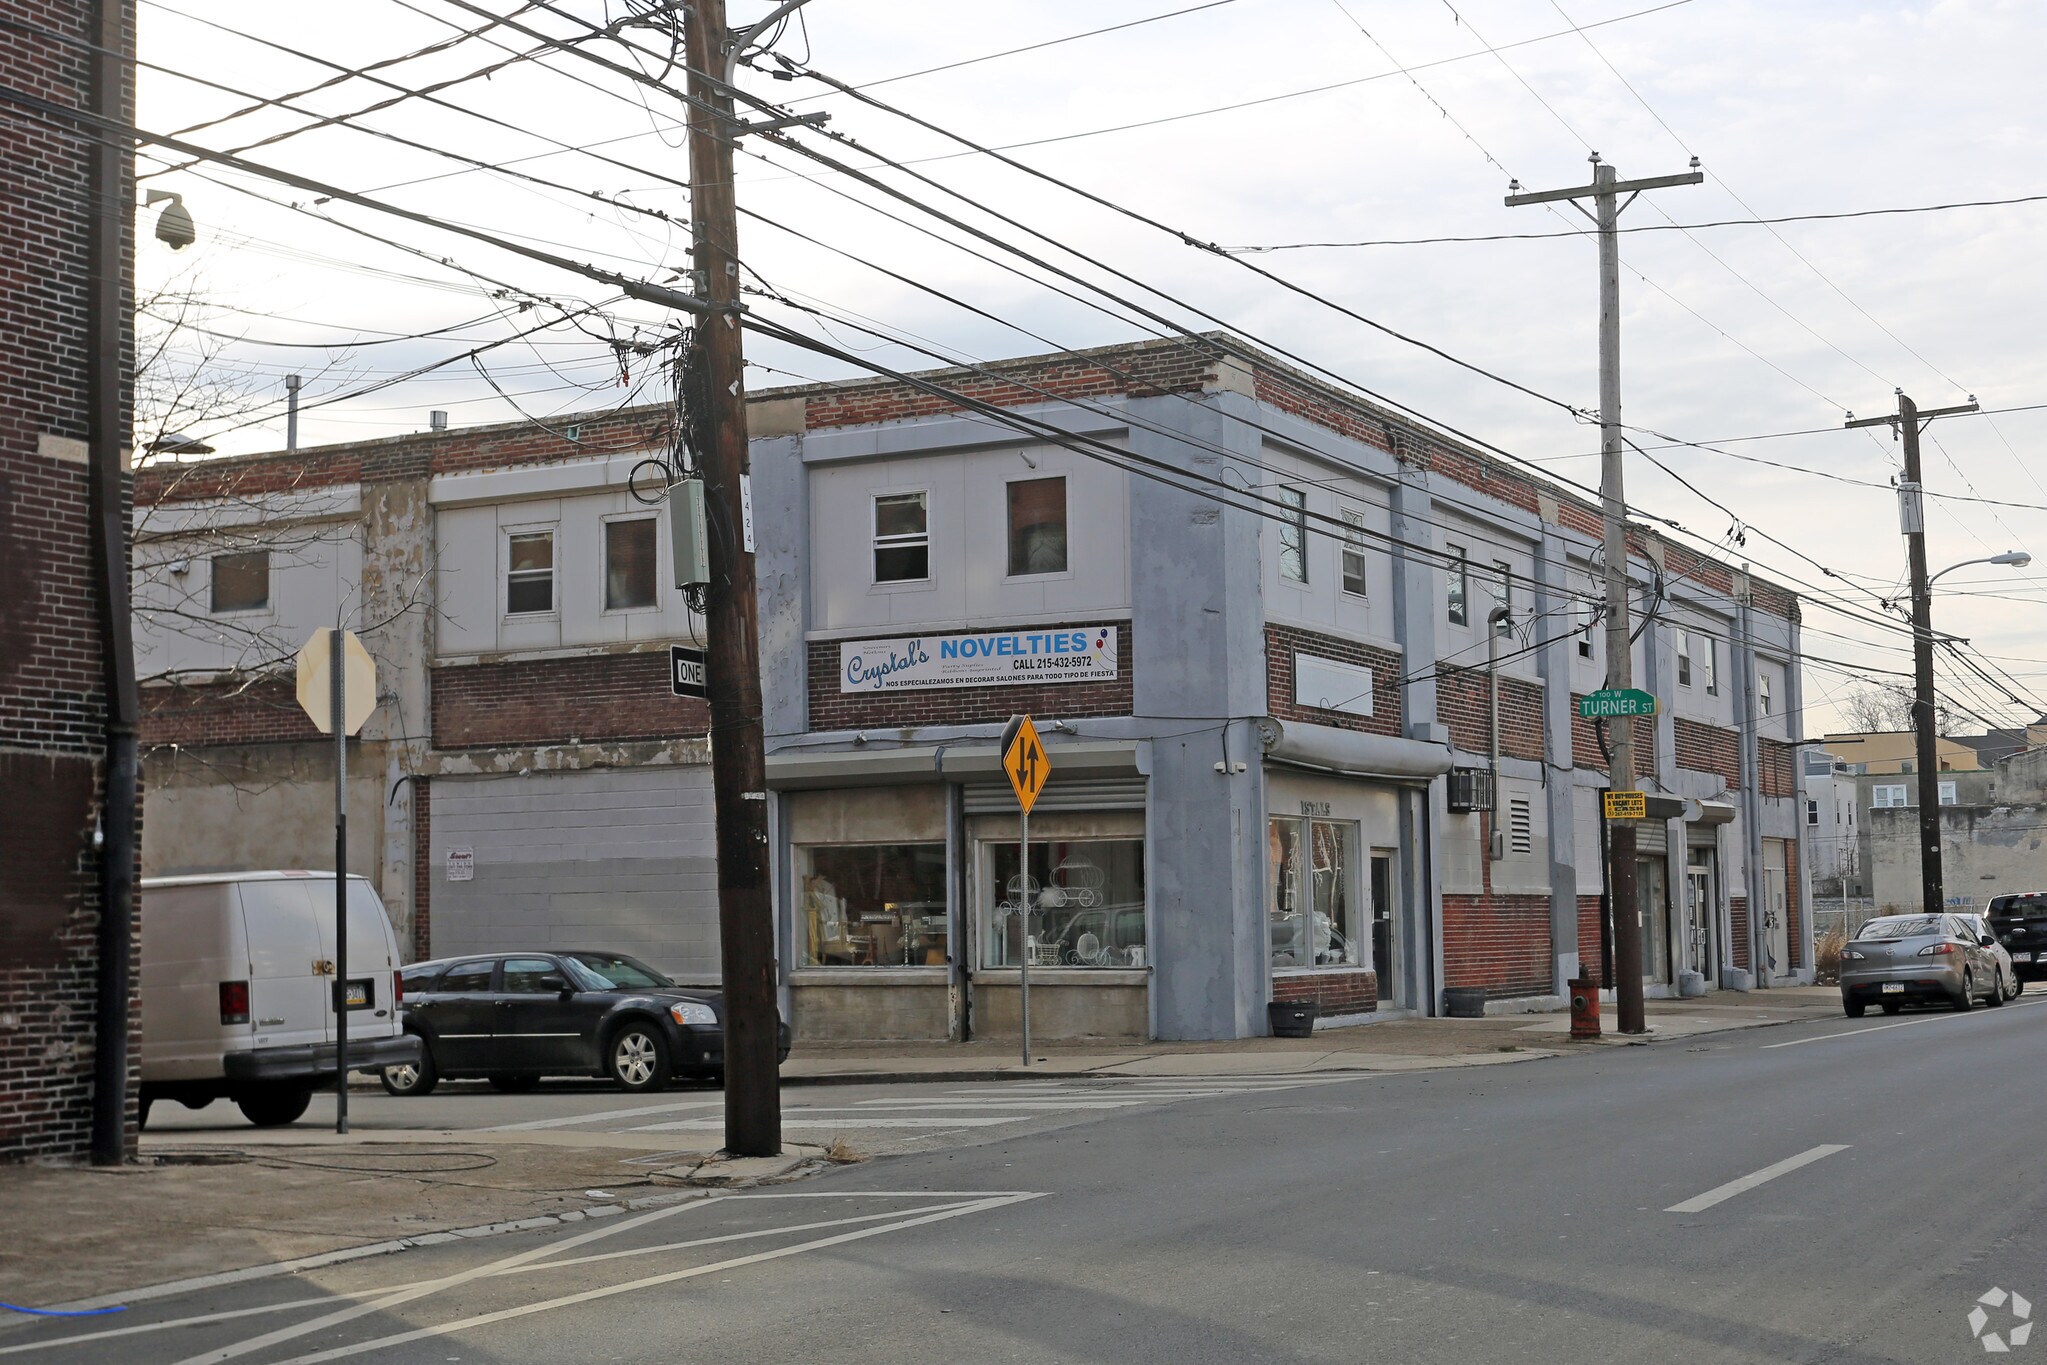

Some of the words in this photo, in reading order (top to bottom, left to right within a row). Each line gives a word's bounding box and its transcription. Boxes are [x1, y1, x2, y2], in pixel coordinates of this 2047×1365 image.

[940, 632, 1087, 659] NOVELTIES
[847, 639, 930, 689] Crystal's
[1013, 658, 1035, 670] CALL
[1037, 656, 1092, 668] 215-432-5972
[680, 662, 702, 683] ONE
[900, 678, 954, 686] ESPECIALEZAMOS
[1614, 690, 1622, 698] W
[1582, 699, 1637, 715] TURNER
[1642, 702, 1653, 713] ST
